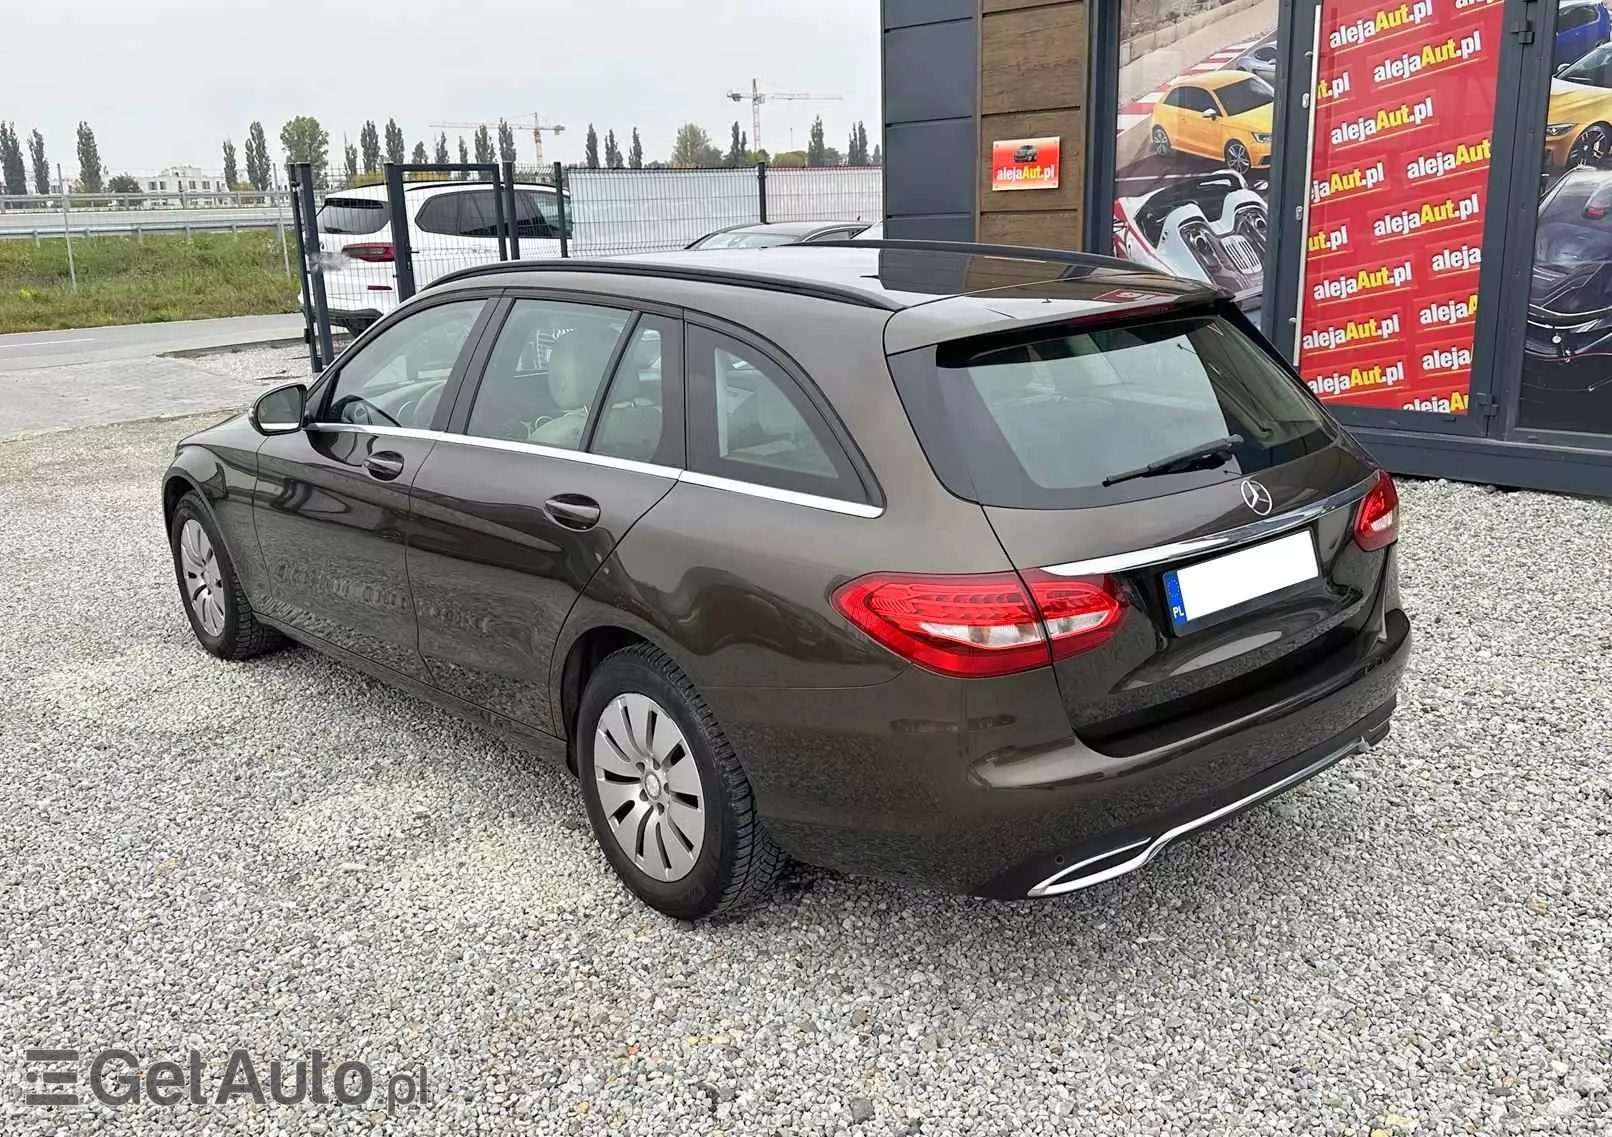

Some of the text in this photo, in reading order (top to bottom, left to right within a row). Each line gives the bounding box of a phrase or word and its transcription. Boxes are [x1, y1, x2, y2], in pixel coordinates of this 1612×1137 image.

[1329, 0, 1432, 48] alejaAut.pl
[1373, 30, 1482, 83] alejaAut.pl
[1331, 97, 1433, 145] alejaAut.pl
[997, 165, 1055, 182] alejaAut.pl
[1373, 193, 1479, 237] alejaAut.pl
[1431, 246, 1481, 272] aleja
[1313, 262, 1412, 301] alejaAut.pl
[1302, 314, 1400, 350] alejaAut.pl
[1422, 344, 1472, 369] aleja
[1307, 361, 1405, 395] alejaAut.pl
[1172, 606, 1185, 618] PL
